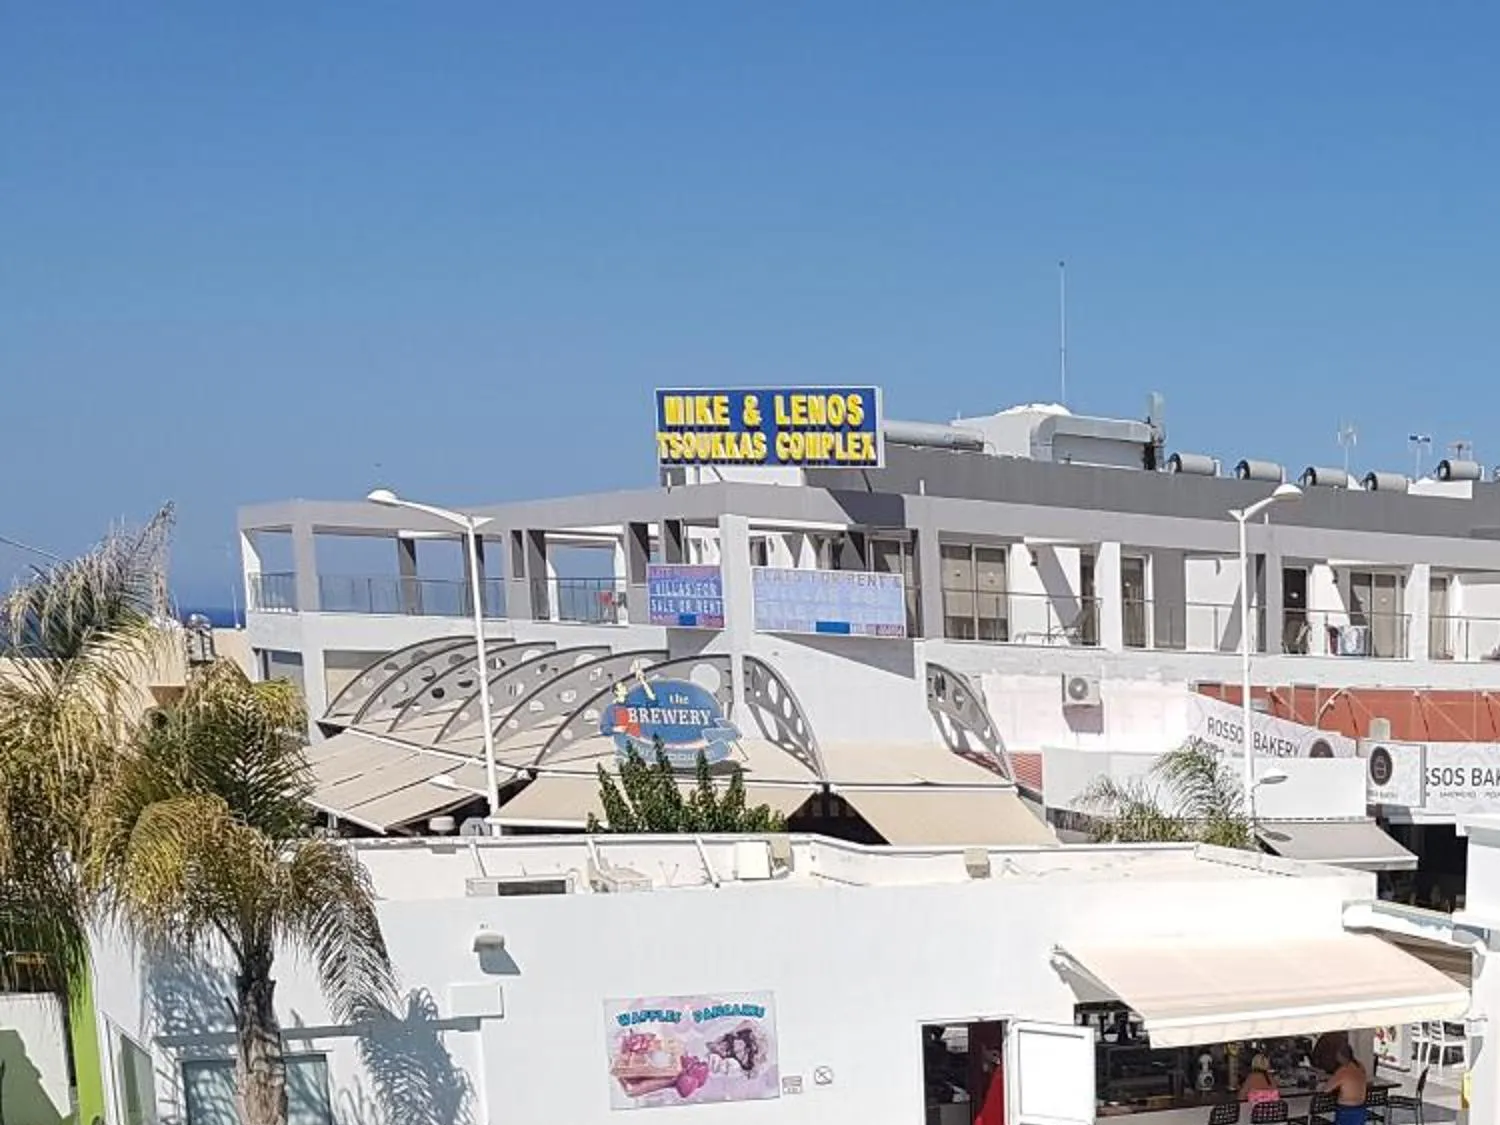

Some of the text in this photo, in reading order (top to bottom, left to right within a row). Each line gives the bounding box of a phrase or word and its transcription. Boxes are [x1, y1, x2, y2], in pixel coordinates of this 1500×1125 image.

[663, 393, 865, 428] MIKE & LENOS
[656, 431, 877, 463] TSOUKKAS COMPLEX
[668, 692, 689, 705] the
[627, 707, 712, 726] BREWERY
[1207, 716, 1300, 758] ROSSO BAKERY
